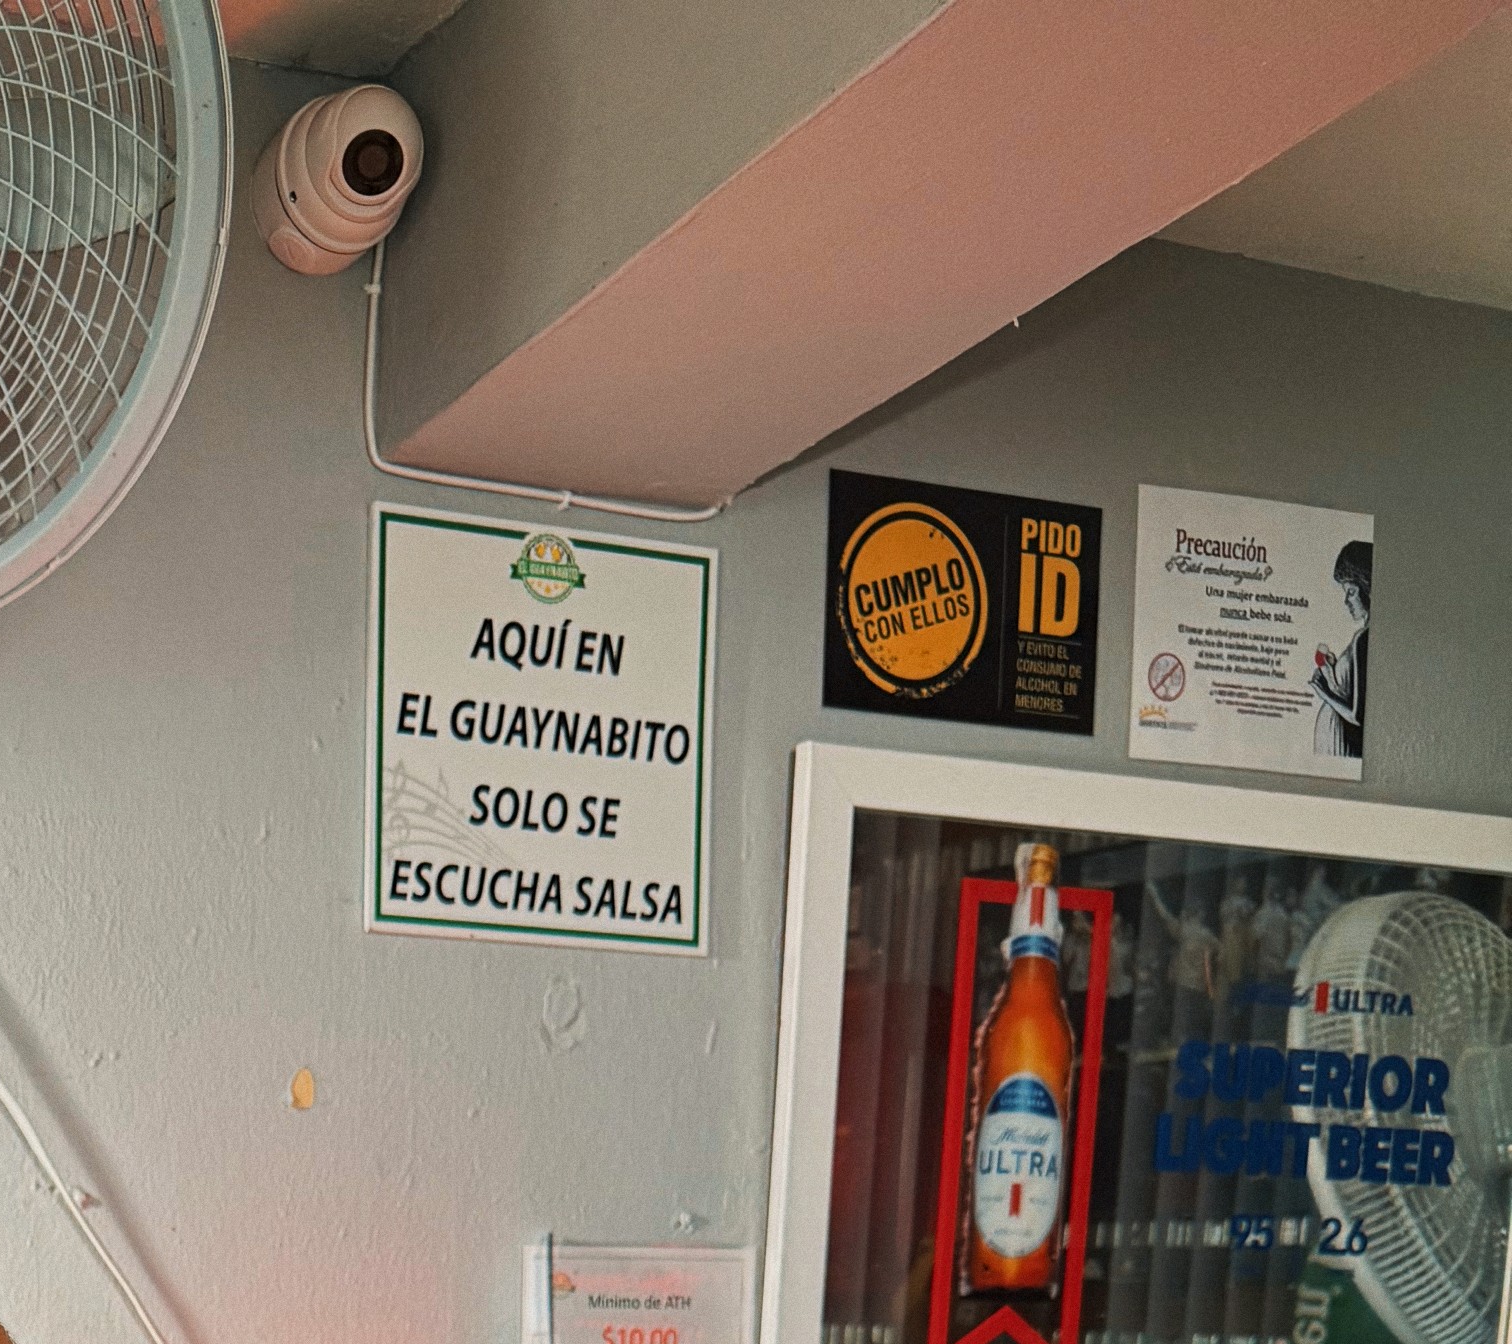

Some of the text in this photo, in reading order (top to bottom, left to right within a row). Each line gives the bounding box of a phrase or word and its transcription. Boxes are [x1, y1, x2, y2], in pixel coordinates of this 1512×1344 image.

[1021, 517, 1082, 558] PIDO
[1175, 528, 1267, 563] Precaución
[854, 558, 965, 618] CUMPLO
[1017, 552, 1081, 637] ID
[1205, 586, 1309, 608] Una mujer embarazada
[863, 594, 970, 644] CON ELLOS
[470, 617, 625, 676] AQUÍ EN
[1057, 646, 1070, 660] EL
[1015, 676, 1062, 695] ALCOHOL
[1016, 657, 1082, 680] CONSUMO DE
[396, 692, 690, 765] EL GUAYNABITO
[468, 784, 620, 838] SOLO SE
[389, 859, 683, 924] ESCUCHA SALSA
[1333, 988, 1414, 1017] ULTRA
[1174, 1040, 1450, 1115] SUPERIOR
[979, 1150, 1058, 1178] ULTRA
[1154, 1112, 1455, 1187] LIGHT BEER
[1230, 1215, 1274, 1251] 95
[644, 1295, 660, 1310] de
